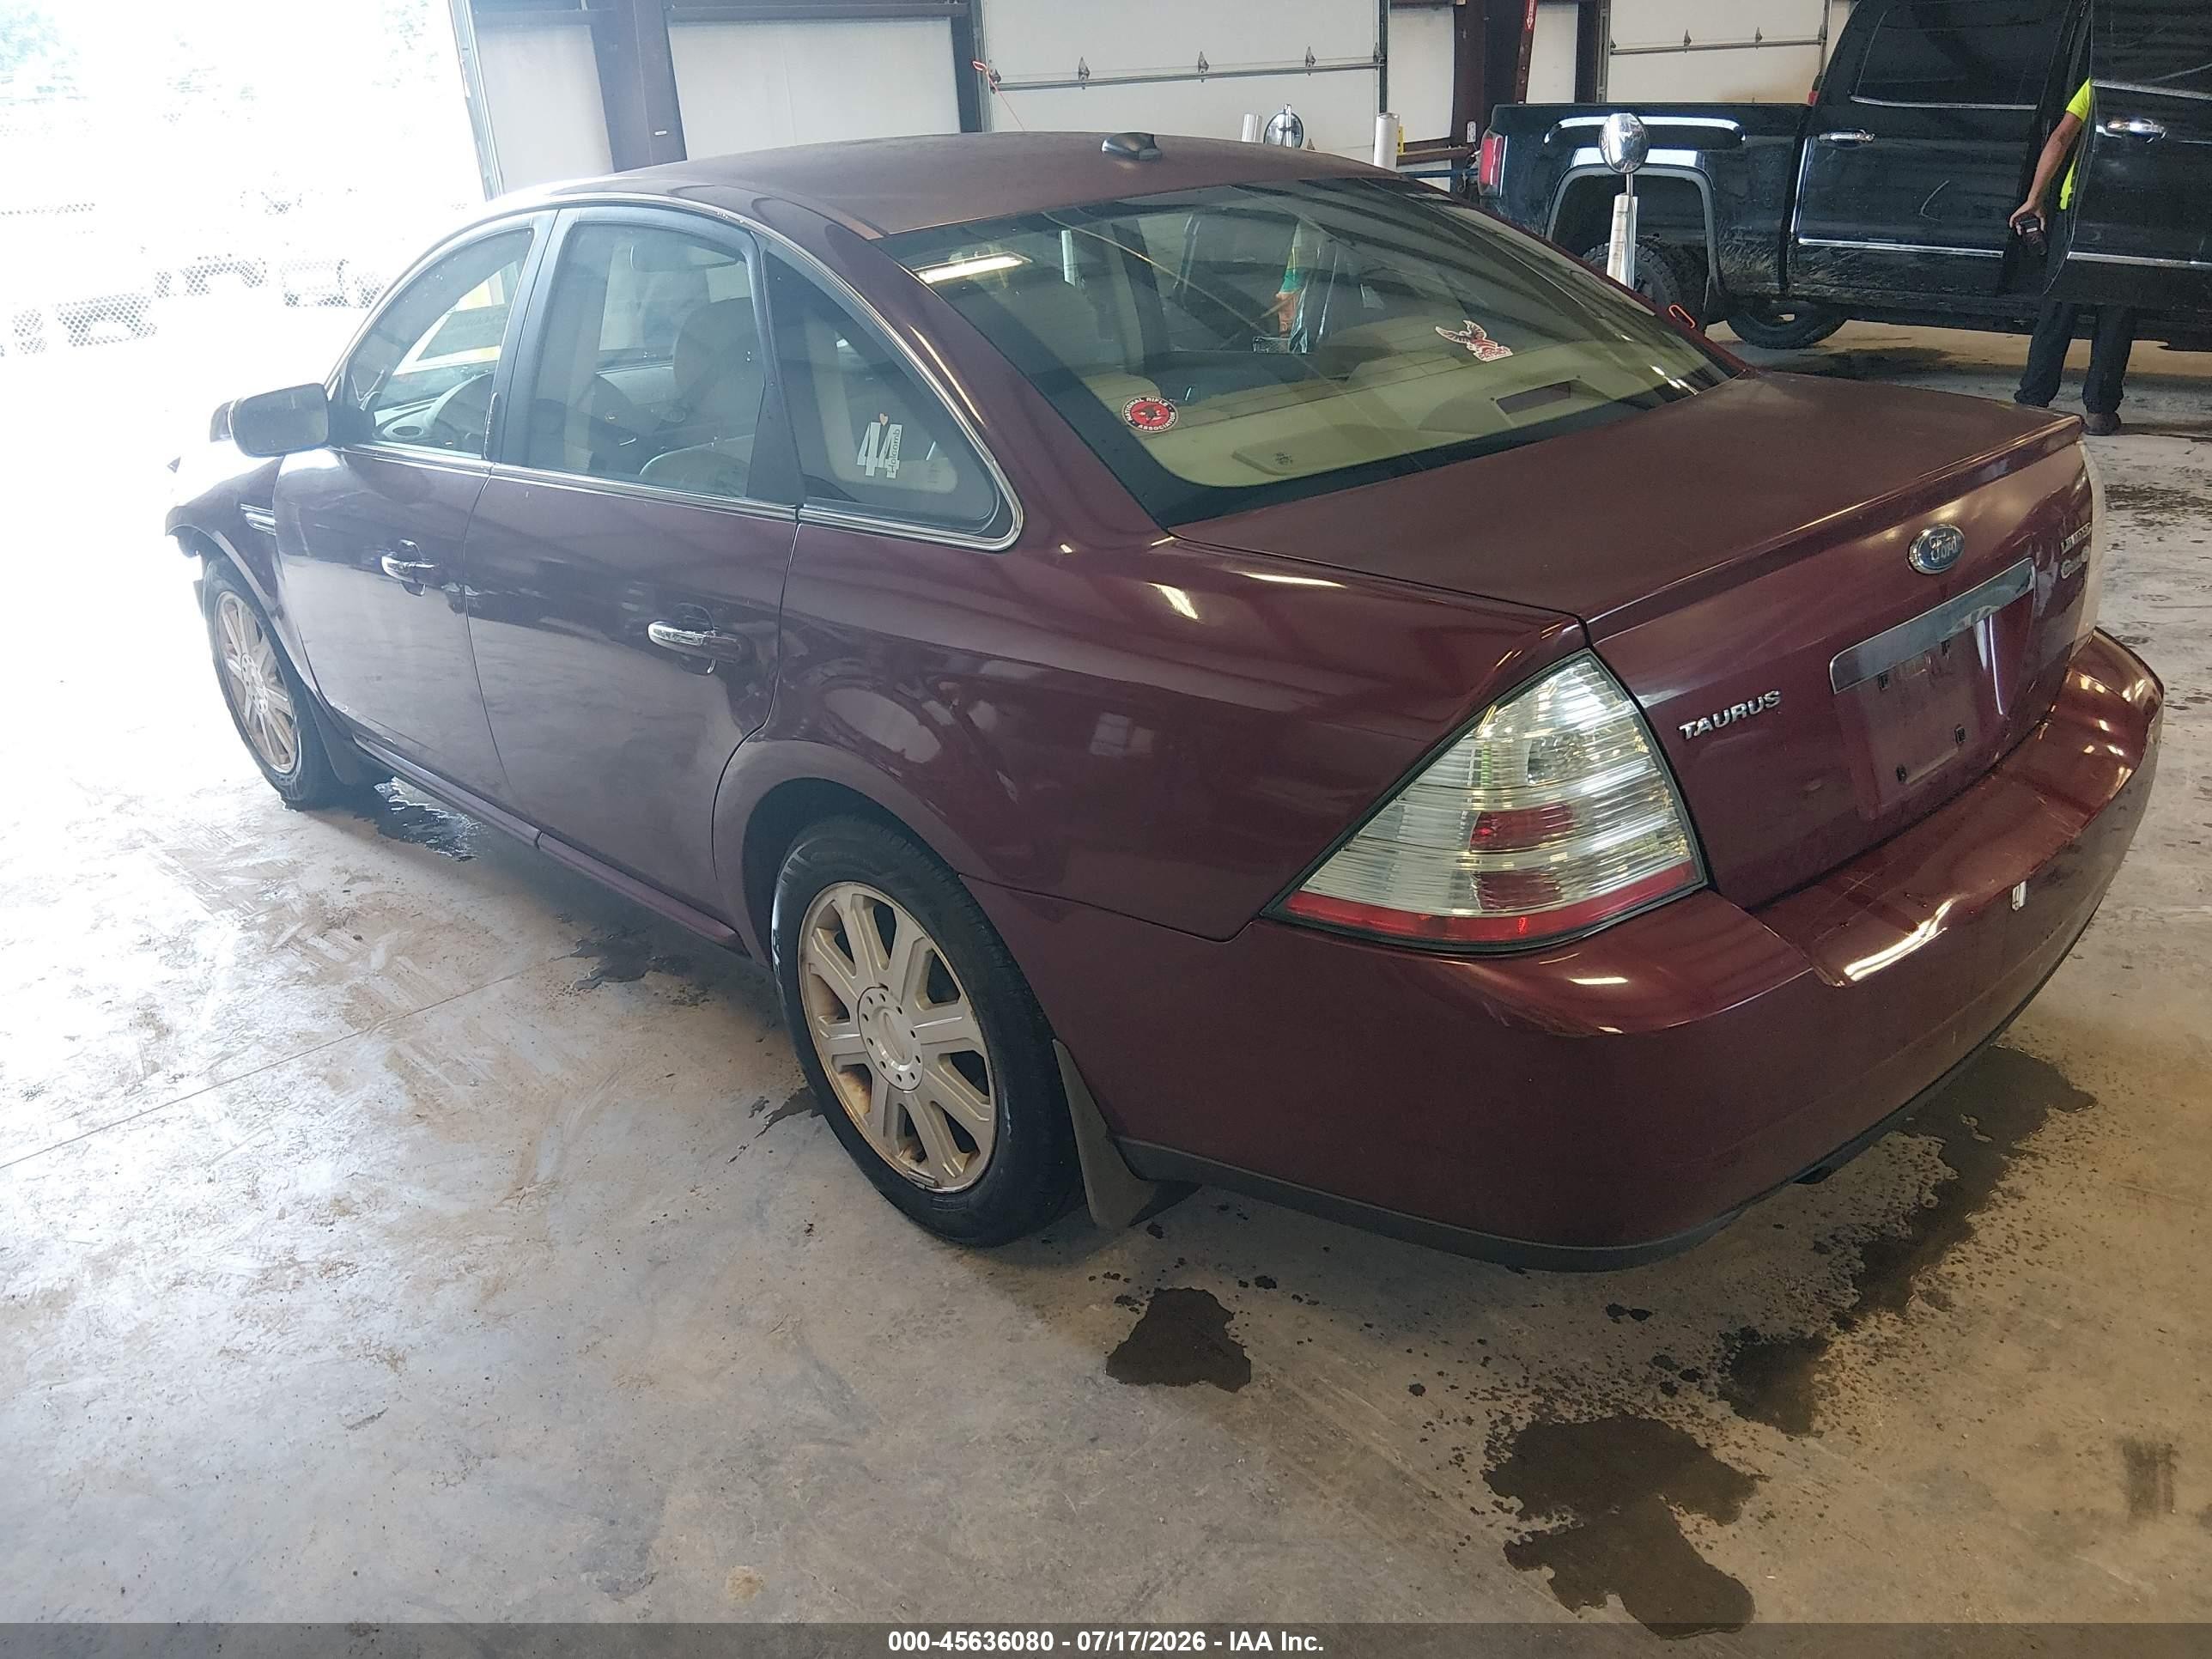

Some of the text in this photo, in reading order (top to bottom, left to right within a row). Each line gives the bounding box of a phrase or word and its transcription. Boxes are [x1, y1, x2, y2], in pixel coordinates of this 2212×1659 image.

[1125, 398, 1169, 421] NATIONAL RIFLE
[1138, 412, 1176, 431] ASSOCIATION
[887, 428, 901, 473] Holcomb
[1929, 532, 1957, 562] Ford
[1678, 690, 1782, 740] TAURUS
